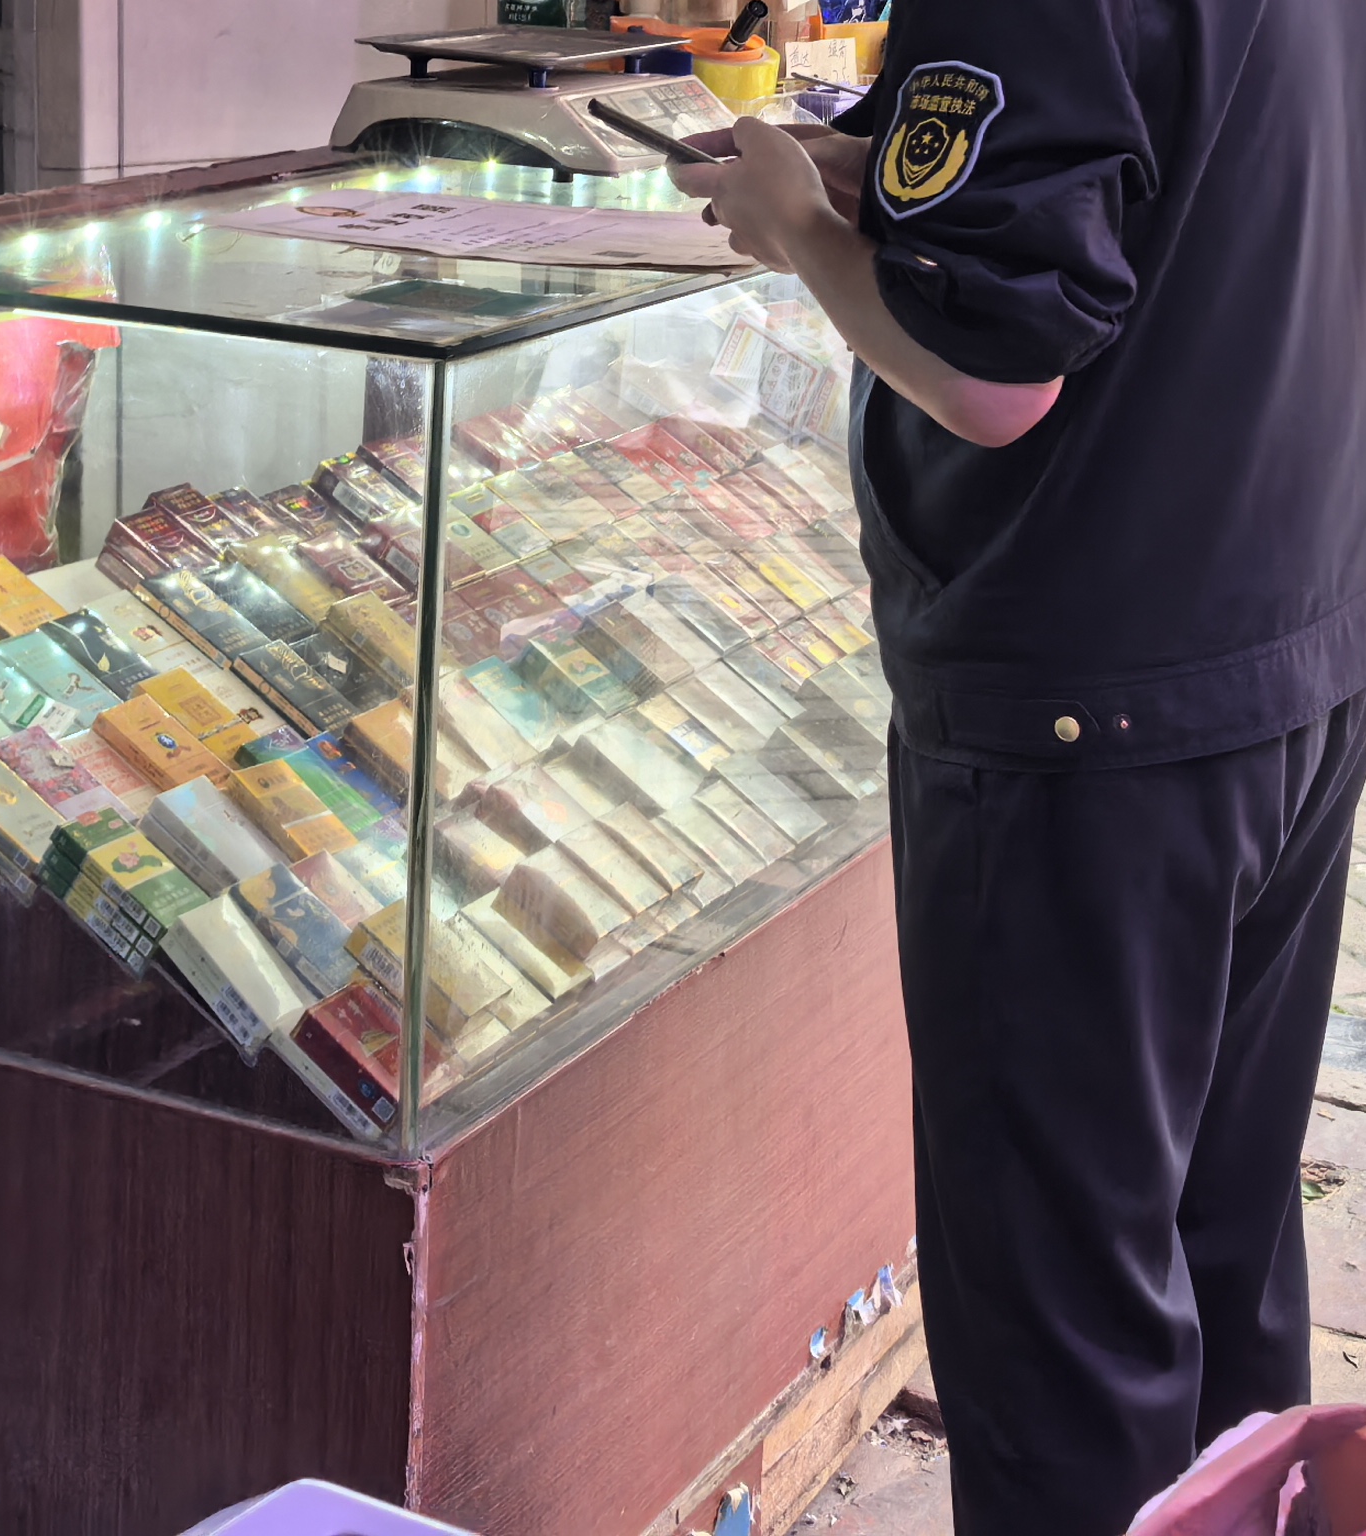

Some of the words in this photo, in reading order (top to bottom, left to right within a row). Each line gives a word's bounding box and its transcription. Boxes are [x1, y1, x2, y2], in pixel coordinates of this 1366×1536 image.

[909, 73, 990, 101] 中华人民共和国
